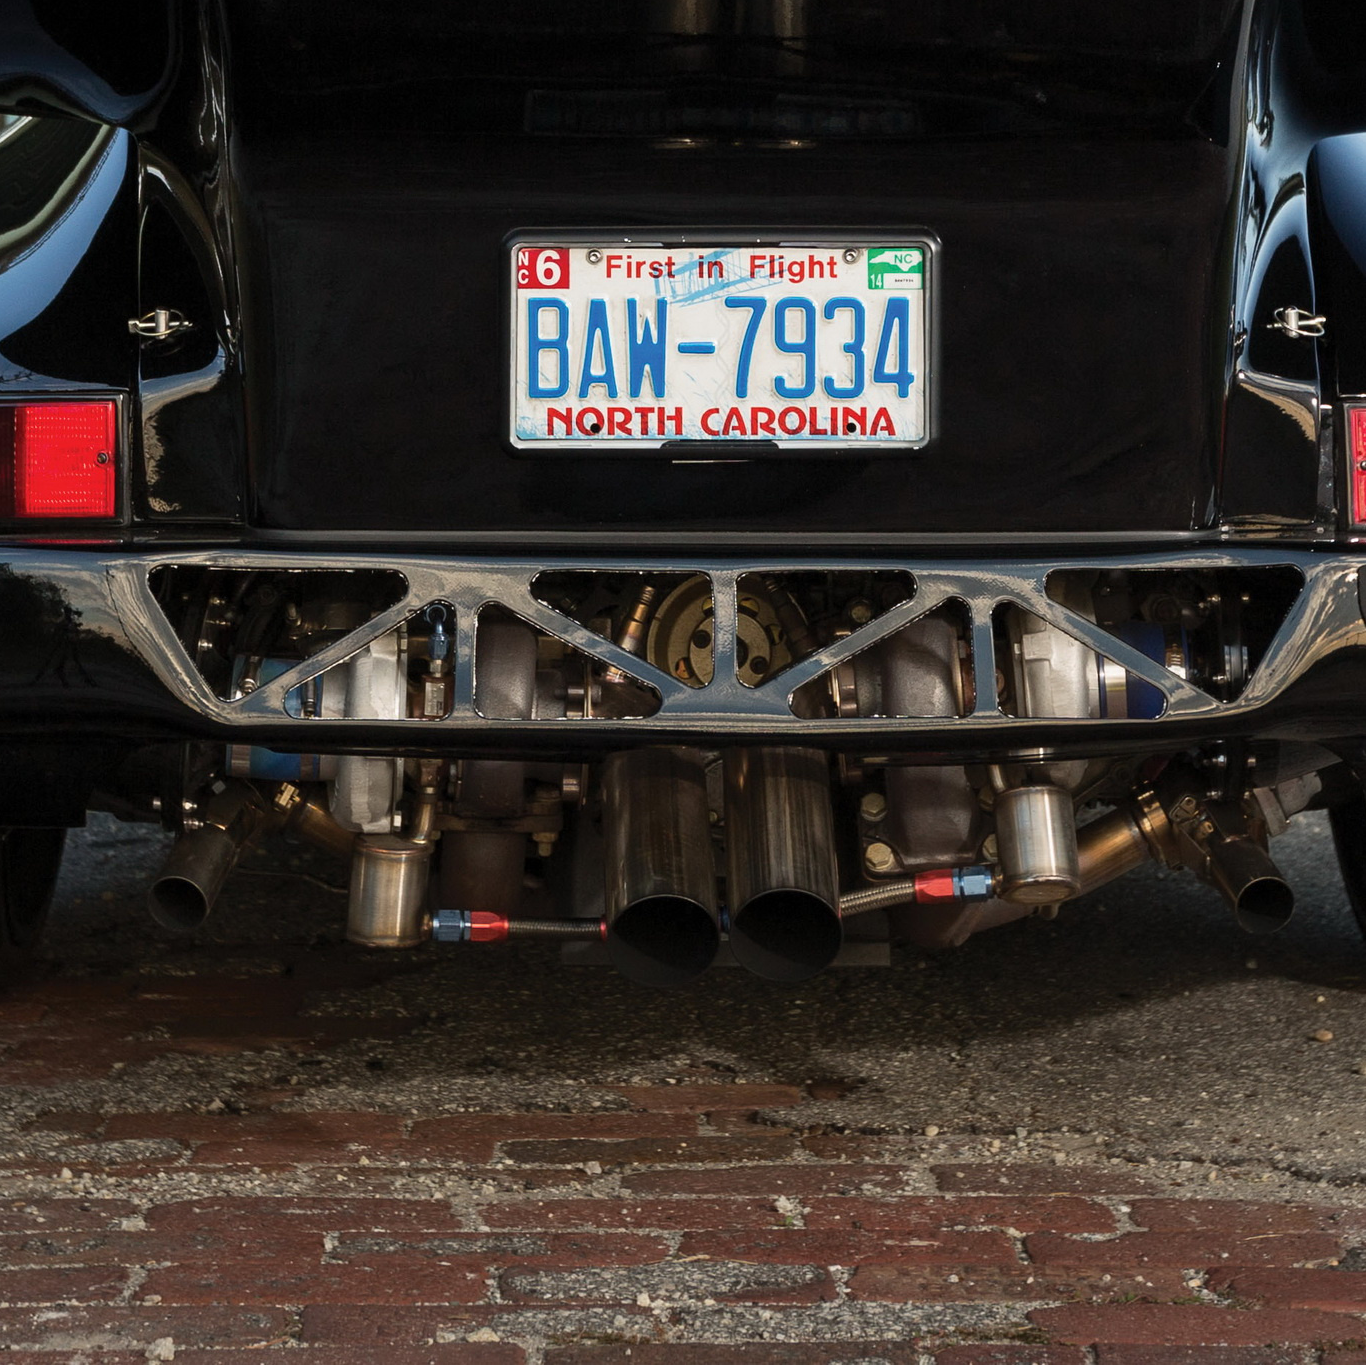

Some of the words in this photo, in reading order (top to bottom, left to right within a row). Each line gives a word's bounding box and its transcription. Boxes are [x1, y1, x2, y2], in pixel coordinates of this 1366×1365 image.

[535, 249, 562, 287] 6
[605, 254, 676, 279] First
[697, 254, 725, 279] in
[749, 254, 838, 284] Flight
[893, 253, 914, 265] NC
[869, 273, 883, 289] 14
[527, 296, 915, 400] BAW-7934
[546, 406, 684, 437] NORTH
[700, 406, 897, 437] CAROLINA
